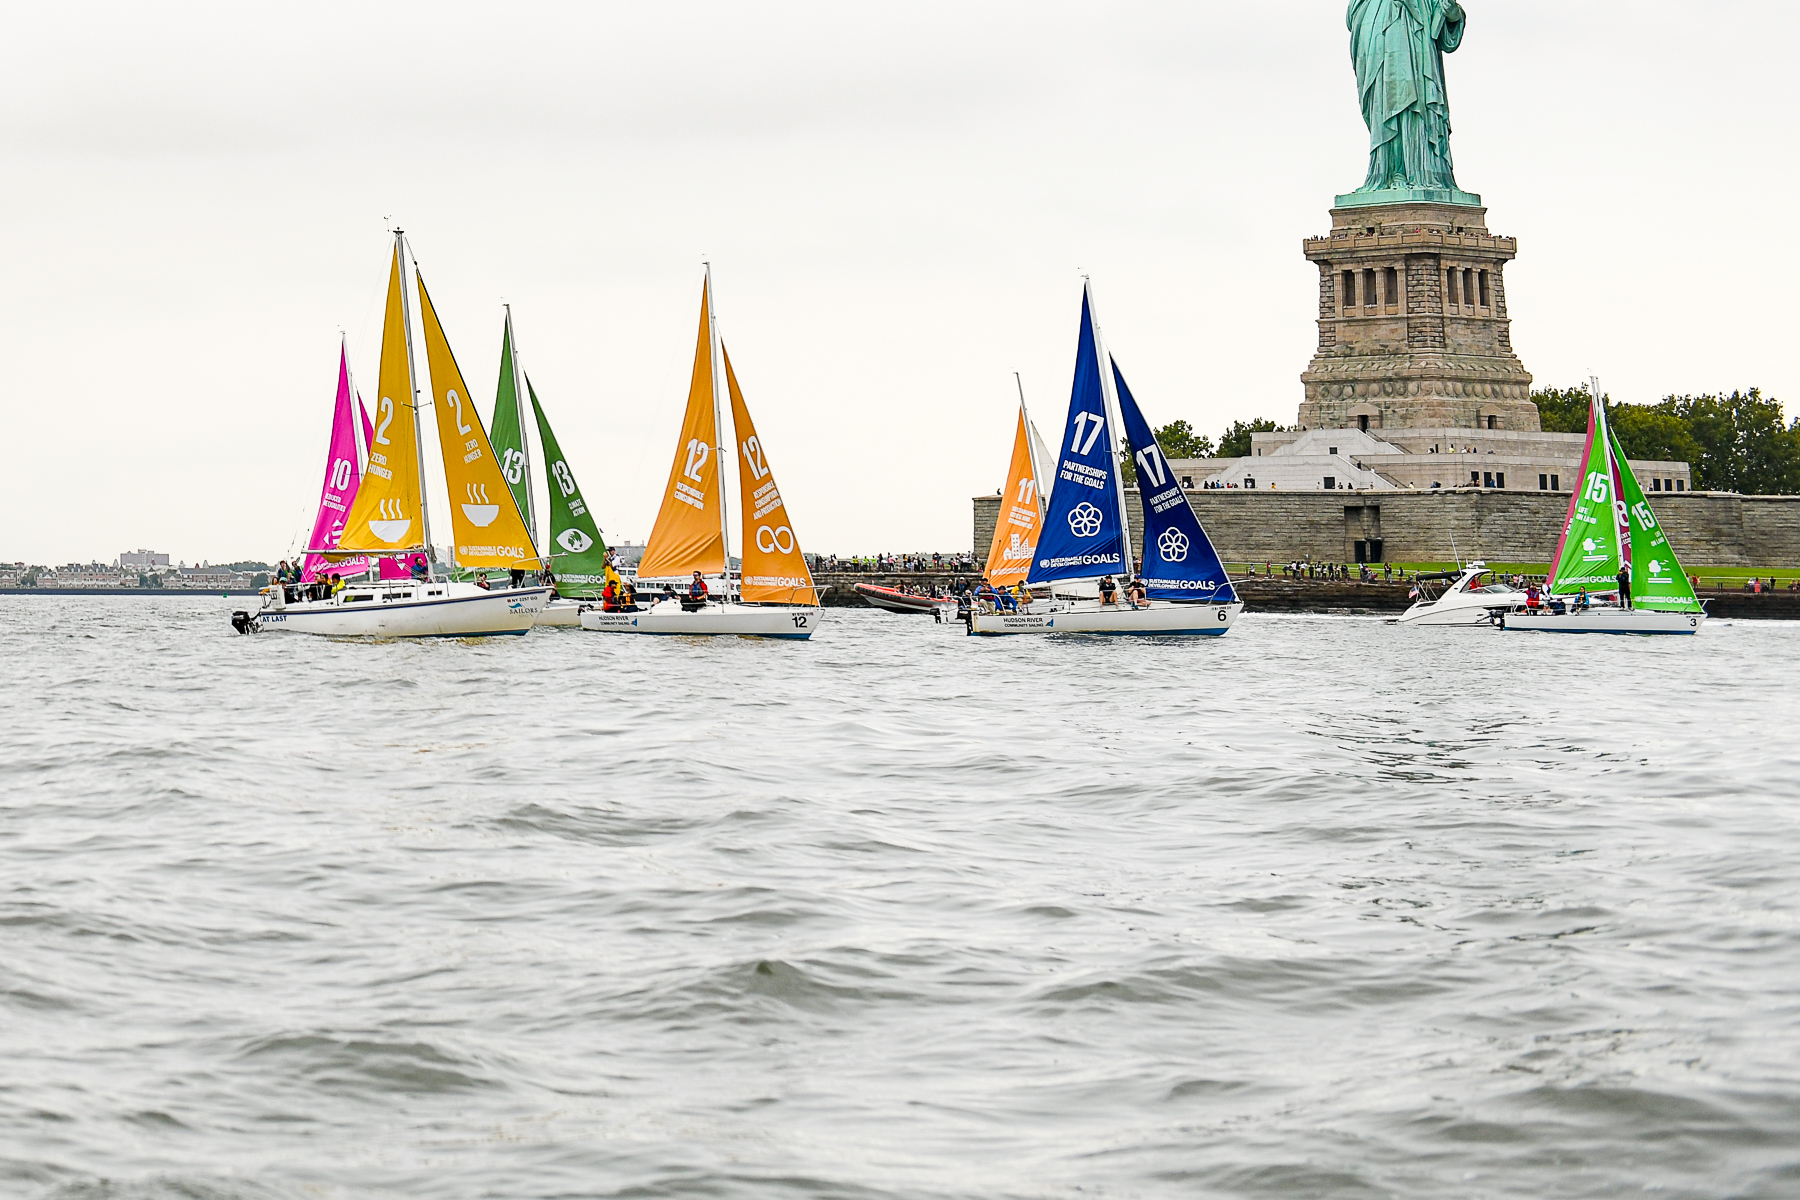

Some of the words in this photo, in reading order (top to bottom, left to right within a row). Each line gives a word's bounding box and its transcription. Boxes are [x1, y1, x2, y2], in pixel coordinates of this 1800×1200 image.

[375, 396, 394, 445] 2
[446, 389, 472, 436] 2
[1070, 410, 1105, 456] 17
[465, 439, 479, 451] ZERO
[371, 452, 387, 465] ZERO
[463, 449, 482, 464] HUNGER
[684, 438, 709, 483] 12
[742, 435, 769, 481] 12
[368, 463, 392, 480] HUNGER
[502, 447, 525, 485] 13
[1063, 460, 1107, 480] PARTNERSHIPS
[1136, 443, 1166, 488] 17
[329, 457, 352, 491] 10
[551, 460, 576, 498] 13
[1060, 469, 1073, 481] FOR
[1073, 473, 1083, 484] THE
[1084, 477, 1105, 490] GOALS
[1017, 477, 1035, 505] 11
[1584, 471, 1610, 503] 15
[1149, 486, 1180, 506] PARTNERSHIPS
[1154, 504, 1164, 514] FOR
[1162, 501, 1171, 511] THE
[1169, 495, 1184, 507] GOALS
[1578, 506, 1589, 515] LIFE
[1576, 513, 1584, 521] ON
[1584, 515, 1597, 525] LAND
[1616, 500, 1629, 527] 8
[1631, 501, 1655, 531] 15
[497, 545, 525, 559] GOALS
[1050, 555, 1082, 563] SUSTAINABLE
[1082, 553, 1120, 565] GOALS
[339, 555, 365, 568] GOALS
[1050, 560, 1082, 568] DEVELOPMENT
[777, 576, 807, 587] GOALS
[1180, 579, 1216, 591] GOALS
[1589, 575, 1617, 584] GOALS
[1666, 596, 1693, 604] GOALS
[509, 607, 538, 615] SAILORS
[1217, 610, 1227, 621] 6
[792, 616, 808, 628] 12
[1690, 618, 1697, 627] 3
